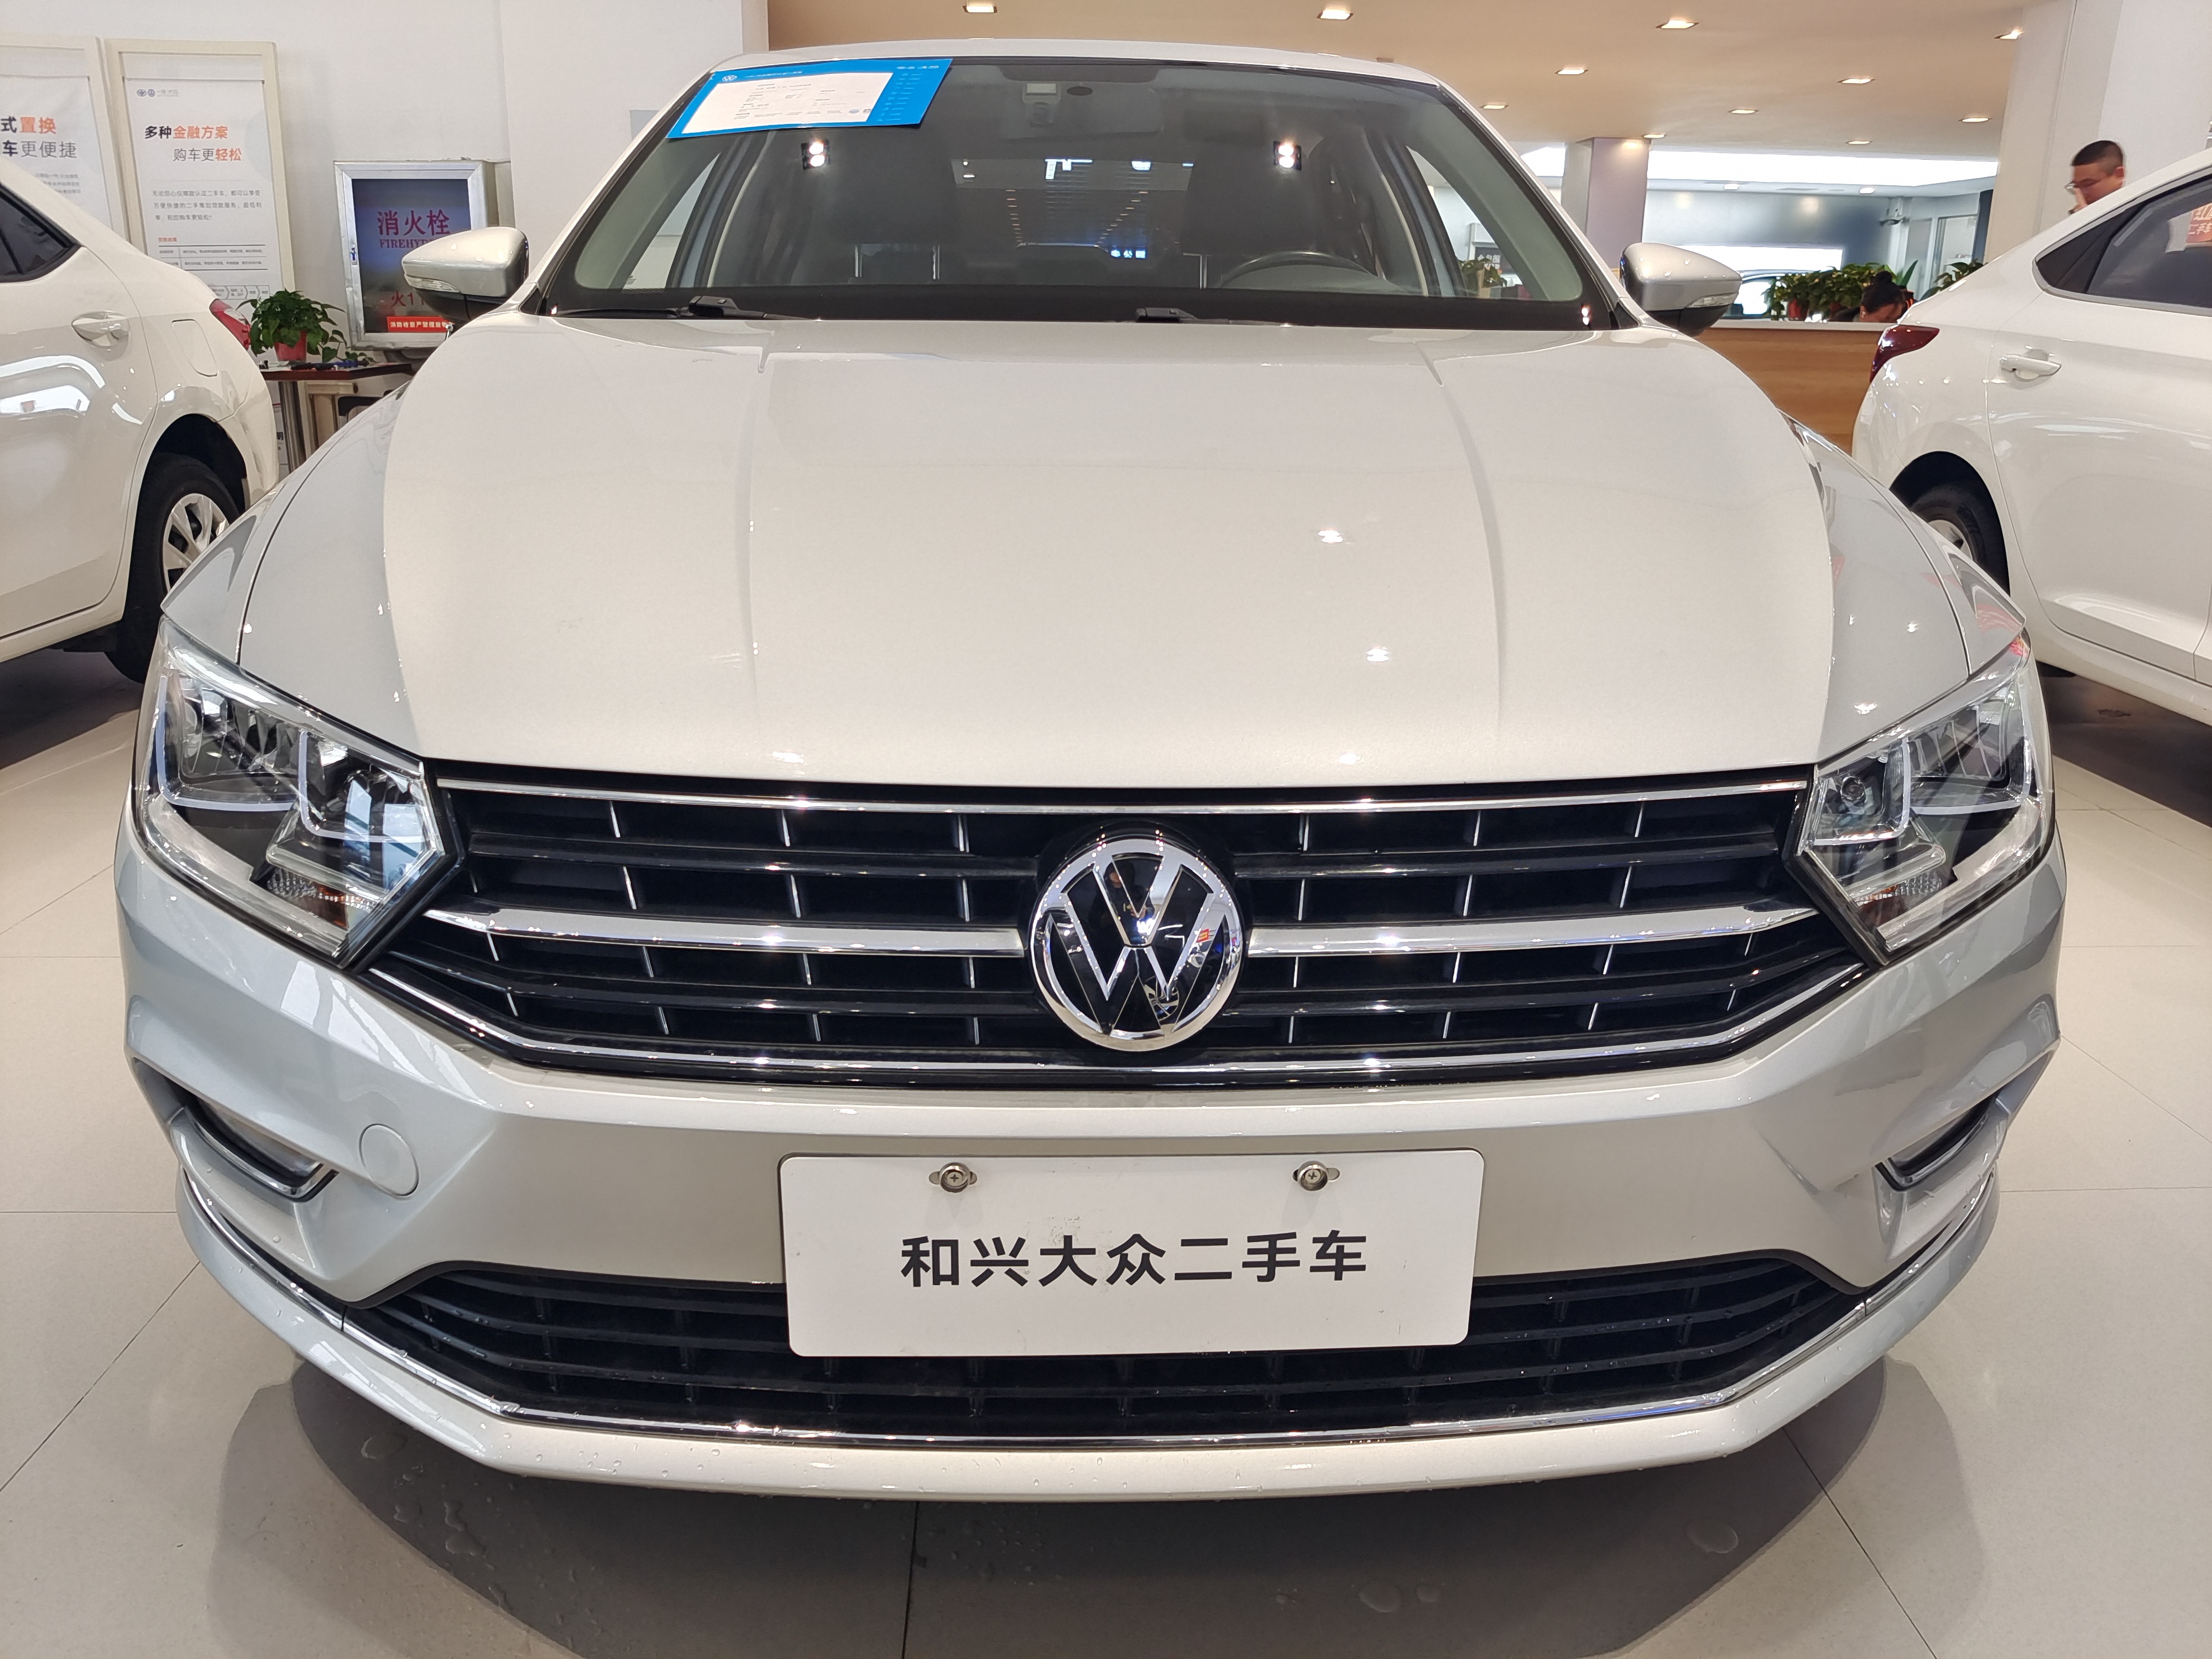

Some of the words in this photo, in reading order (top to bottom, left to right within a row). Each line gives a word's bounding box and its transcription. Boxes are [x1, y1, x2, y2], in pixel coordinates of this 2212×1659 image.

[1, 116, 56, 134] 式置换
[145, 126, 228, 139] 多种金融方案
[2, 140, 77, 158] 车更便捷
[173, 148, 242, 162] 购车更轻松
[377, 209, 451, 236] 消火栓
[900, 1229, 1368, 1287] 和兴大众二手车
